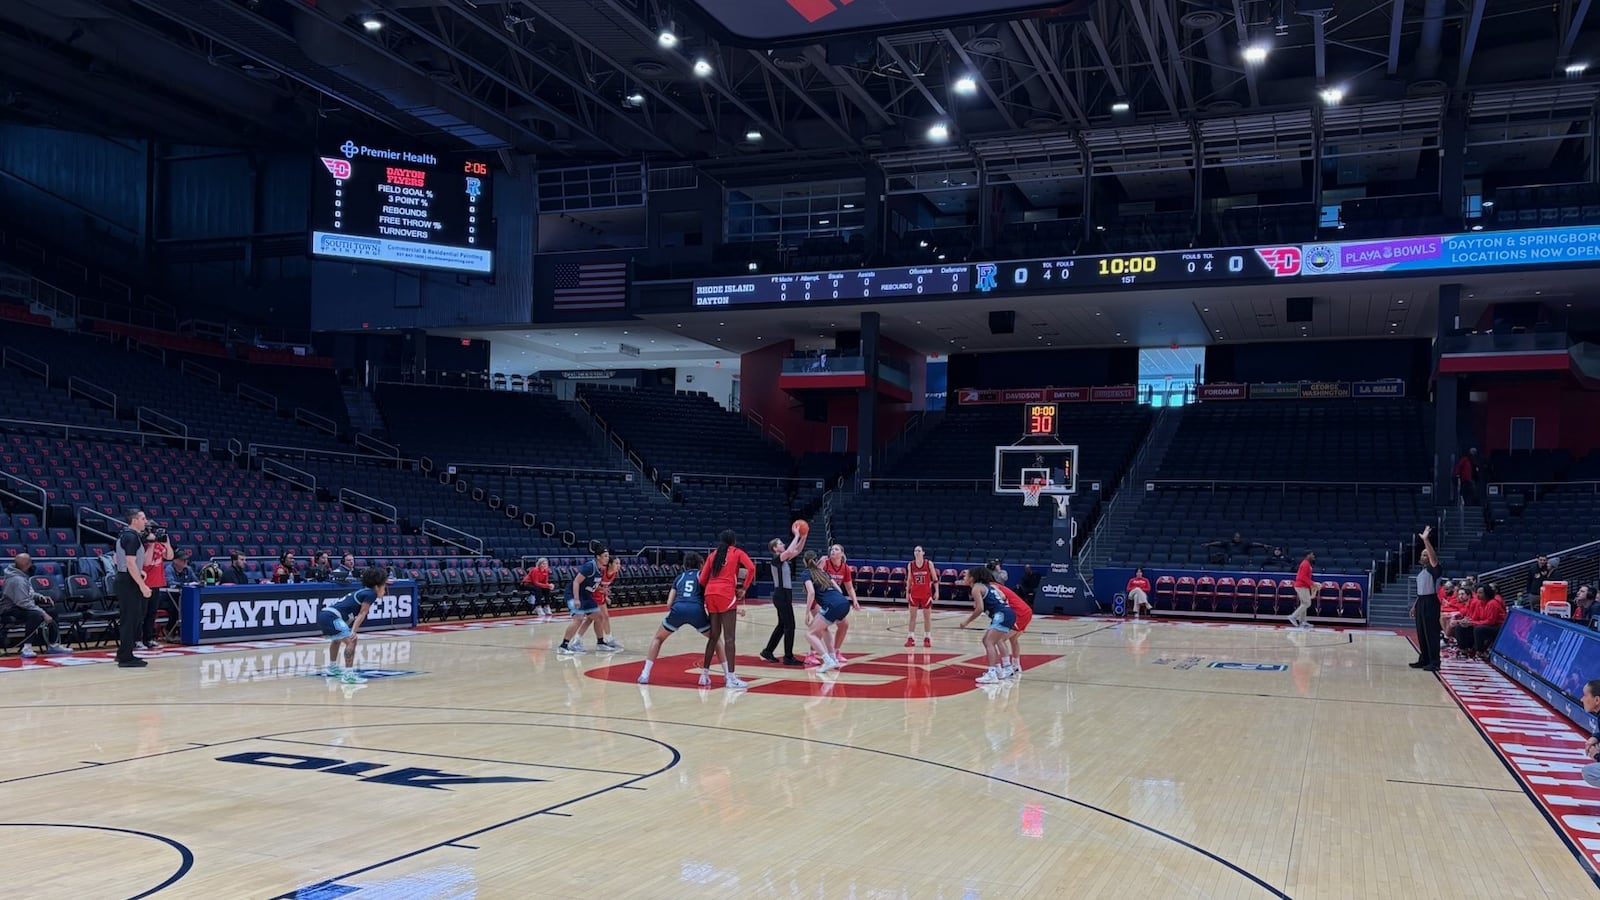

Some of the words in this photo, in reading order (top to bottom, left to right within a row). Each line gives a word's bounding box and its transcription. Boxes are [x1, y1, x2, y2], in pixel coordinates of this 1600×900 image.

[360, 146, 401, 161] Premier
[403, 151, 437, 165] Health
[386, 167, 426, 180] DAYTON
[464, 161, 487, 174] 2:06
[387, 176, 424, 187] FLYERS
[378, 184, 401, 194] FIELD
[402, 186, 425, 197] GOAL
[426, 190, 433, 198] %
[395, 196, 420, 206] POINT
[335, 210, 341, 218] 0
[382, 206, 428, 218] REBOUNDS
[379, 216, 401, 226] FREE
[402, 218, 432, 229] THROW
[379, 226, 428, 238] TURNOVERS
[324, 239, 351, 250] SOUTH
[354, 242, 378, 252] TOWN
[1450, 238, 1503, 250] DAYTON
[1506, 236, 1516, 247] &
[1520, 232, 1600, 246] SPRINGBOR
[1346, 250, 1382, 263] PLAYA
[1394, 243, 1436, 257] BOWLS
[1452, 250, 1528, 263] LOCATIONS
[1531, 248, 1563, 260] NOW
[1099, 257, 1156, 274] 10:00
[1188, 262, 1196, 272] 0
[1204, 261, 1213, 272] 4
[1229, 256, 1243, 272] 0
[1015, 268, 1028, 284] 0
[1043, 270, 1051, 280] 4
[1062, 269, 1069, 279] 0
[1122, 276, 1136, 284] 1ST
[864, 278, 869, 286] 0
[881, 283, 913, 291] REBOUNDS
[952, 284, 958, 292] 0
[696, 286, 724, 294] RHODE
[724, 284, 755, 293] ISLAND
[696, 297, 729, 305] DAYTON
[781, 293, 786, 301] 0
[1302, 389, 1348, 397] WASHINGTON
[1032, 406, 1055, 416] 10:00
[1032, 416, 1051, 432] 30
[684, 580, 694, 592] 5
[1042, 584, 1076, 594] altafiber
[201, 598, 319, 631] DAYTON
